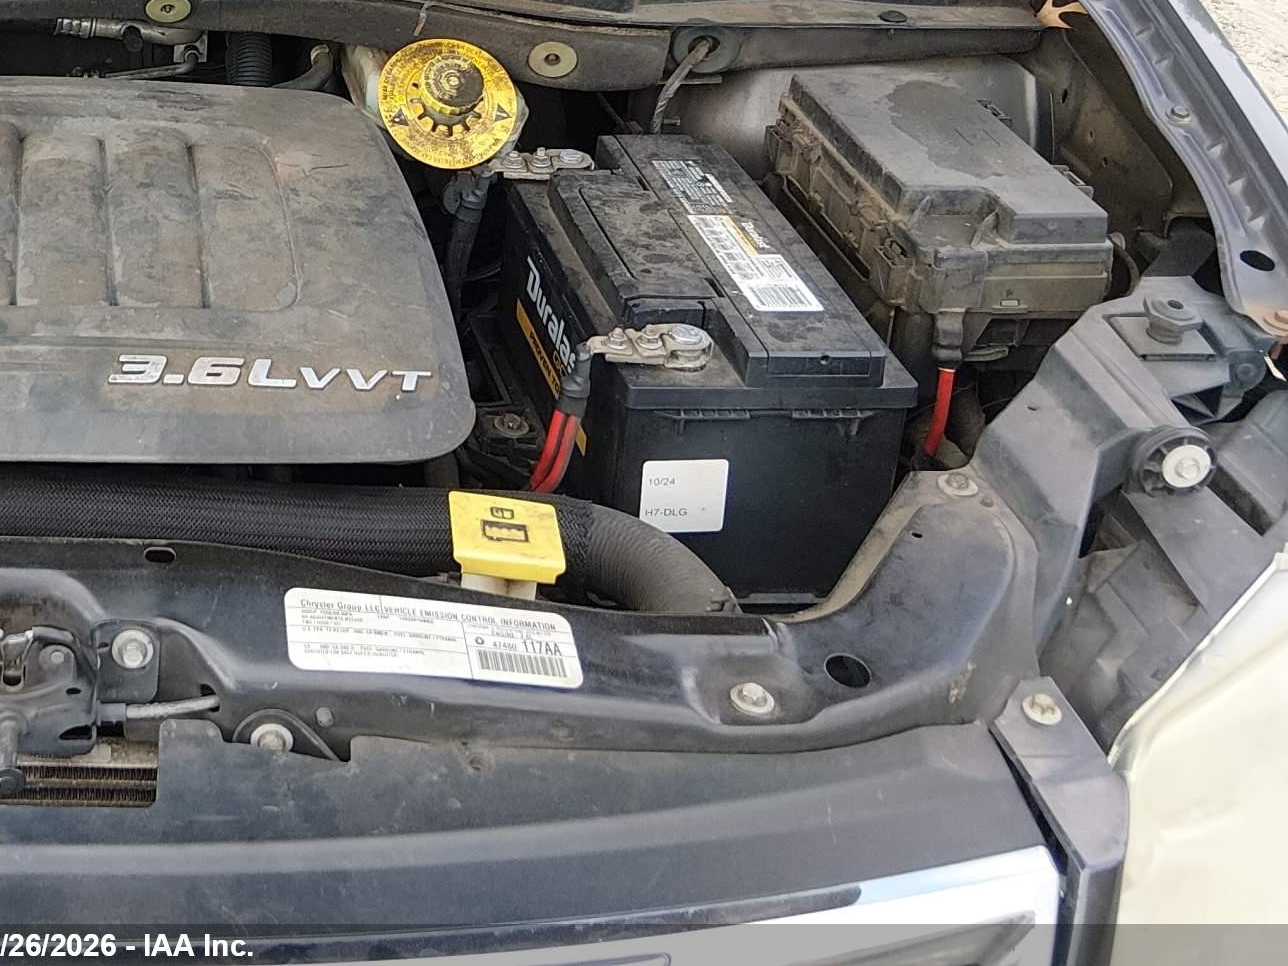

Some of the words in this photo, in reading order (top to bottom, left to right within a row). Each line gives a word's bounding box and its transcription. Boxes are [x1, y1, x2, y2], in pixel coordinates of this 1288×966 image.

[526, 255, 576, 375] Duralas
[648, 477, 676, 487] 10/24
[645, 507, 688, 517] H7-DLG
[300, 599, 334, 610] Chrysler
[337, 601, 362, 612] Group
[365, 604, 380, 612] LLC
[383, 606, 417, 616] VEHICLE
[419, 609, 459, 620] EMISSION
[461, 613, 497, 625] CONTROL
[500, 618, 557, 631] INFORMATION
[522, 639, 563, 657] 117AA
